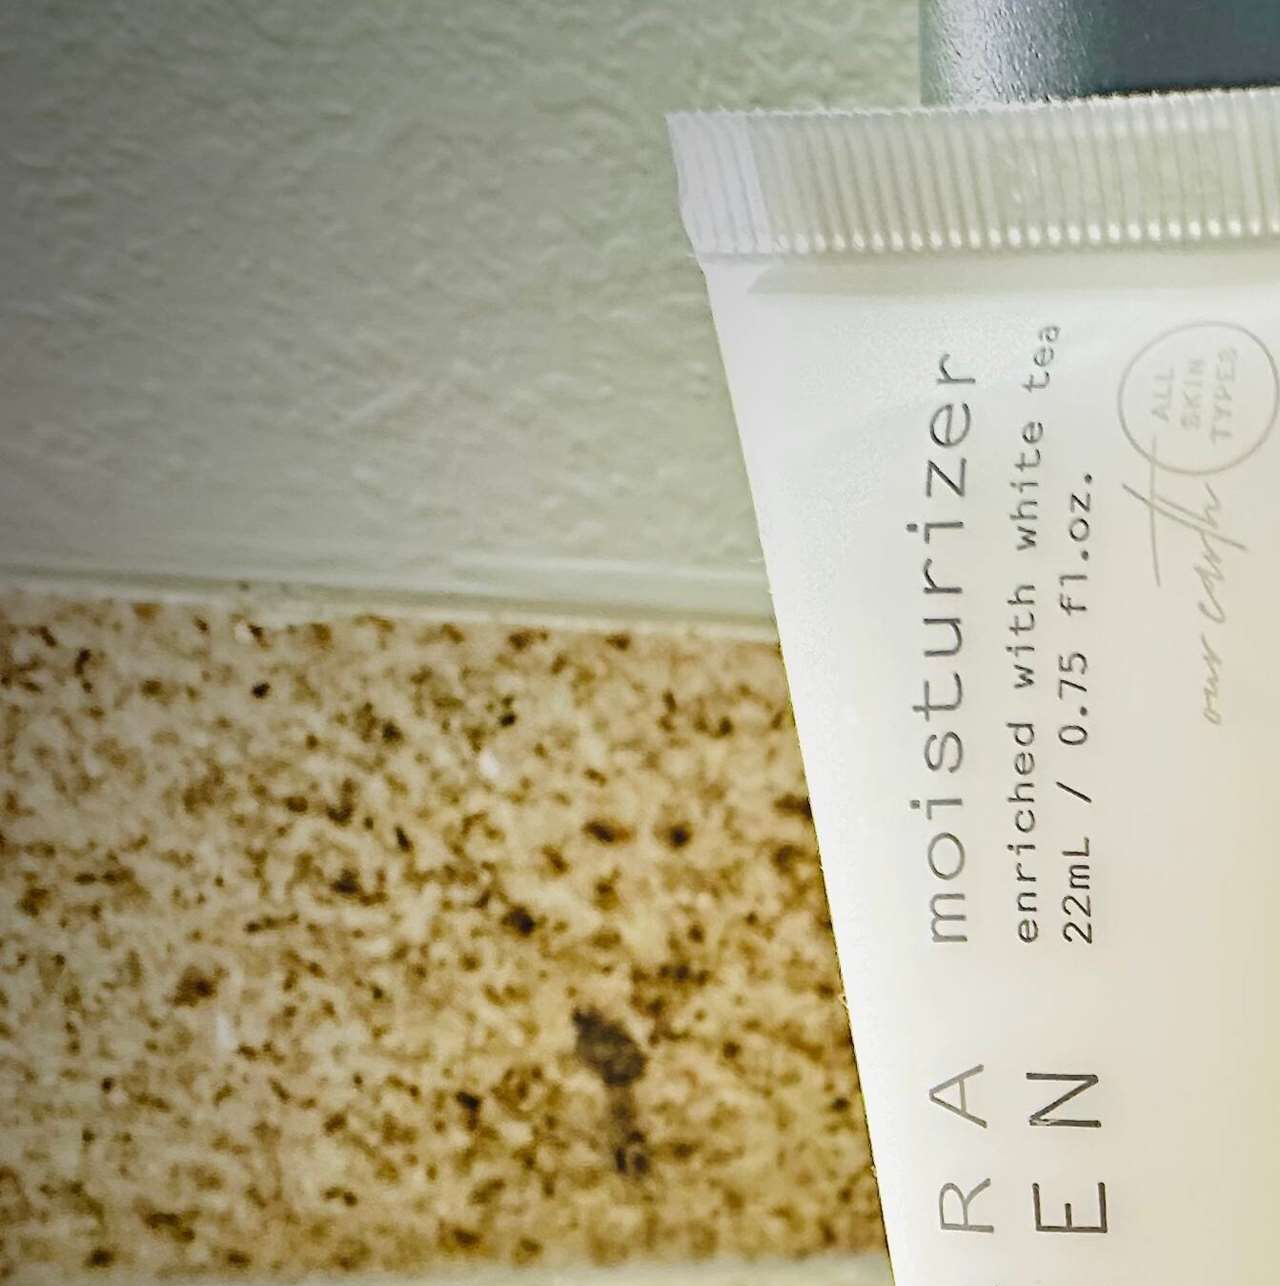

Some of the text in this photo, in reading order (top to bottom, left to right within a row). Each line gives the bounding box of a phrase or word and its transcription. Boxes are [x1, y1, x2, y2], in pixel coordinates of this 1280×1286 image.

[909, 354, 976, 943] moisturizer
[1006, 324, 1060, 943] enriched with white tea
[1057, 471, 1093, 944] 22mL / 0.75 fl.oz.
